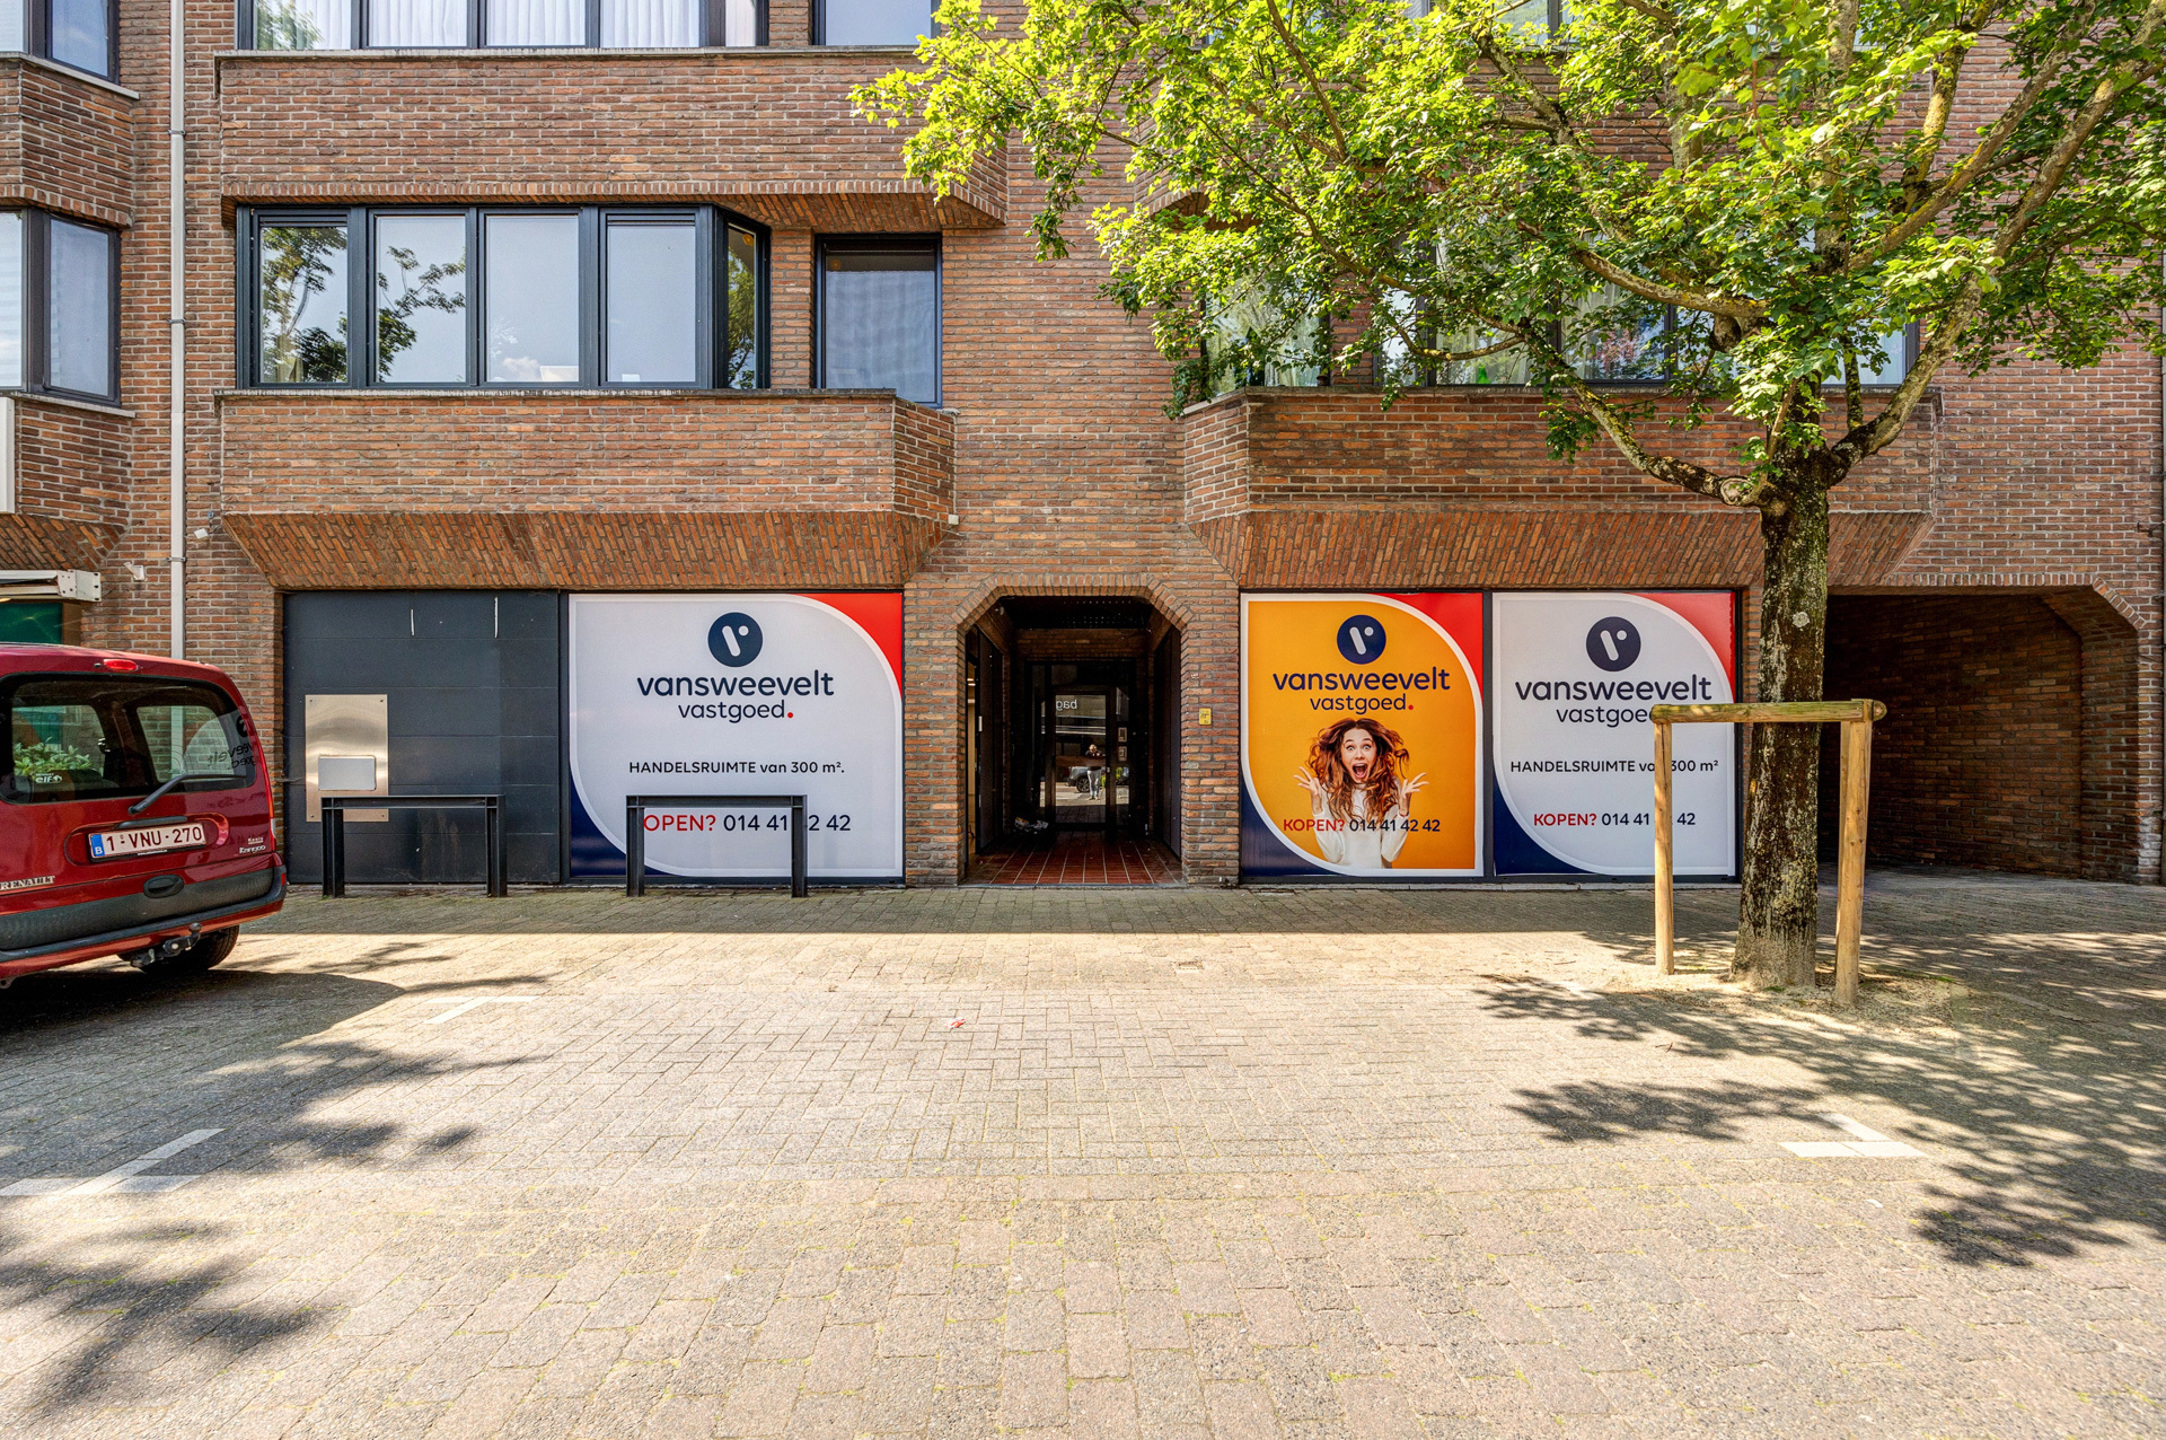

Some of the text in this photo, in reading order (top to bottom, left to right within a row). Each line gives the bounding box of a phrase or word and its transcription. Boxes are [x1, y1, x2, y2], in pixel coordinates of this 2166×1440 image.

[637, 669, 834, 697] vansweevelt
[1273, 666, 1450, 691] vansweevelt
[1515, 673, 1712, 701] vansweevelt
[678, 699, 794, 724] vastgoed.
[1310, 693, 1414, 715] vastgoed.
[1556, 705, 1653, 727] vastgoe
[629, 761, 756, 774] HANDELSRUIMTE
[760, 763, 787, 774] van
[791, 761, 818, 774] 300
[1510, 760, 1635, 773] HANDELSRUIMTE
[1638, 763, 1655, 772] va
[644, 814, 716, 832] OPEN?
[723, 814, 760, 832] 014
[766, 814, 788, 832] 41
[826, 814, 851, 832] 42
[1283, 818, 1441, 832] KOPEN? 014 41 42 42
[1534, 813, 1597, 826] KOPEN?
[1602, 813, 1629, 826] 014
[1633, 813, 1650, 826] 41
[1677, 813, 1696, 826] 42
[0, 875, 55, 890] RENAULT
